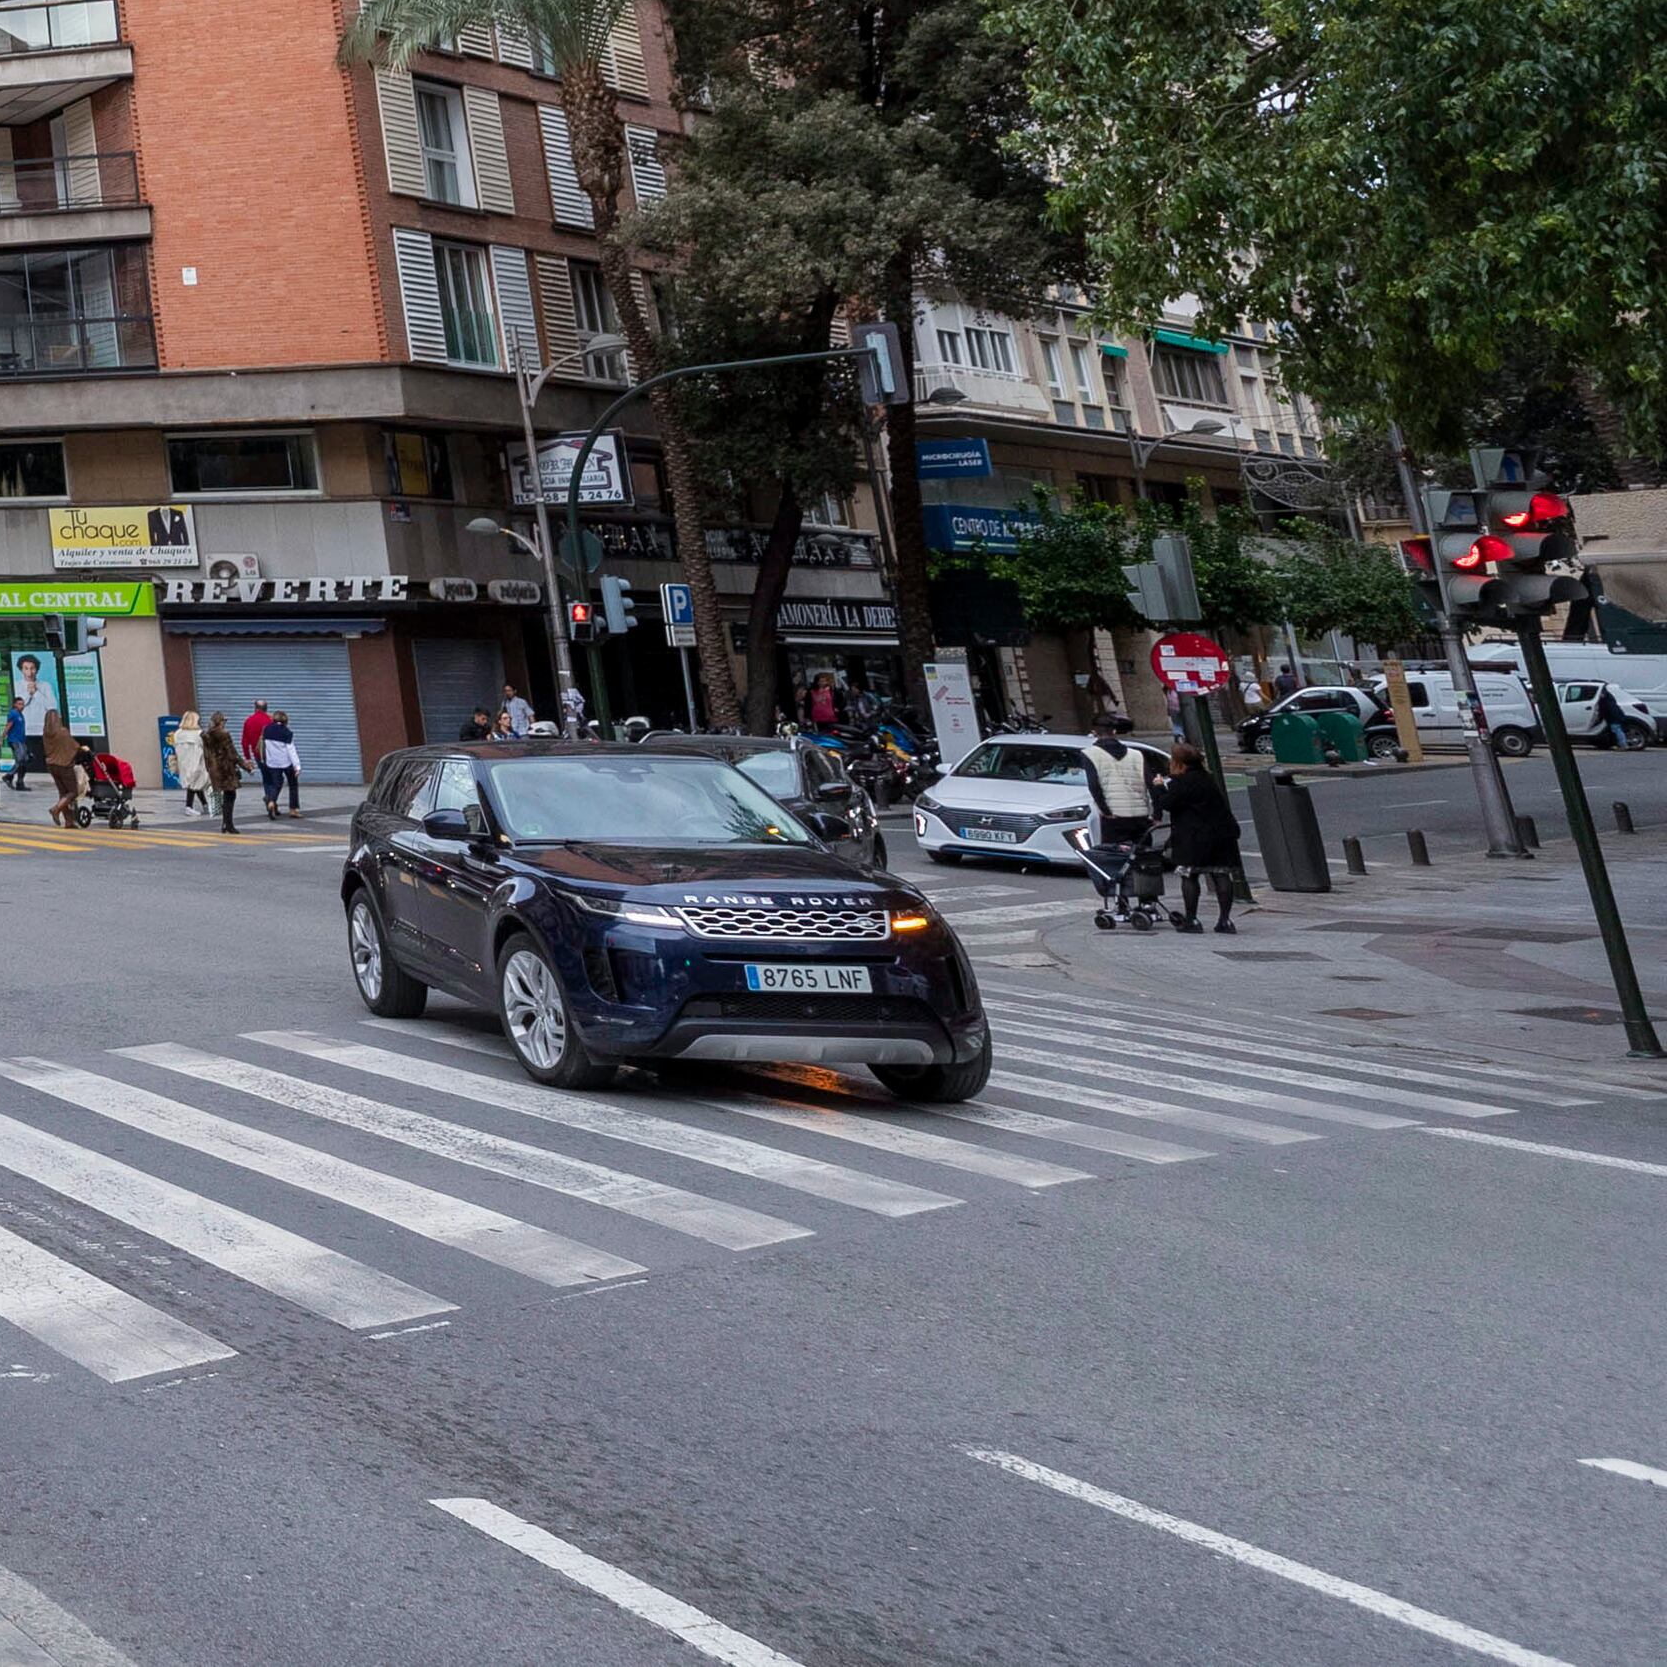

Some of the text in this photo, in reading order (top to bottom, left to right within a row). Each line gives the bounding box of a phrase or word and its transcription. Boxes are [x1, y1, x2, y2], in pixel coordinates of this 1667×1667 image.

[586, 490, 603, 500] 24
[606, 489, 622, 500] 76
[64, 509, 87, 526] Tu
[952, 516, 988, 537] CENTRO
[989, 520, 1002, 537] DE
[59, 522, 140, 547] chaque
[59, 547, 96, 558] Alquiler
[99, 549, 105, 557] y
[107, 548, 134, 556] venta
[136, 547, 147, 556] de
[29, 591, 129, 608] CENTRAL
[163, 575, 409, 603] REVERTE
[673, 588, 687, 620] P
[843, 605, 861, 627] LA
[683, 894, 874, 907] RANGE ROVER
[763, 968, 863, 990] 8765 LNF
